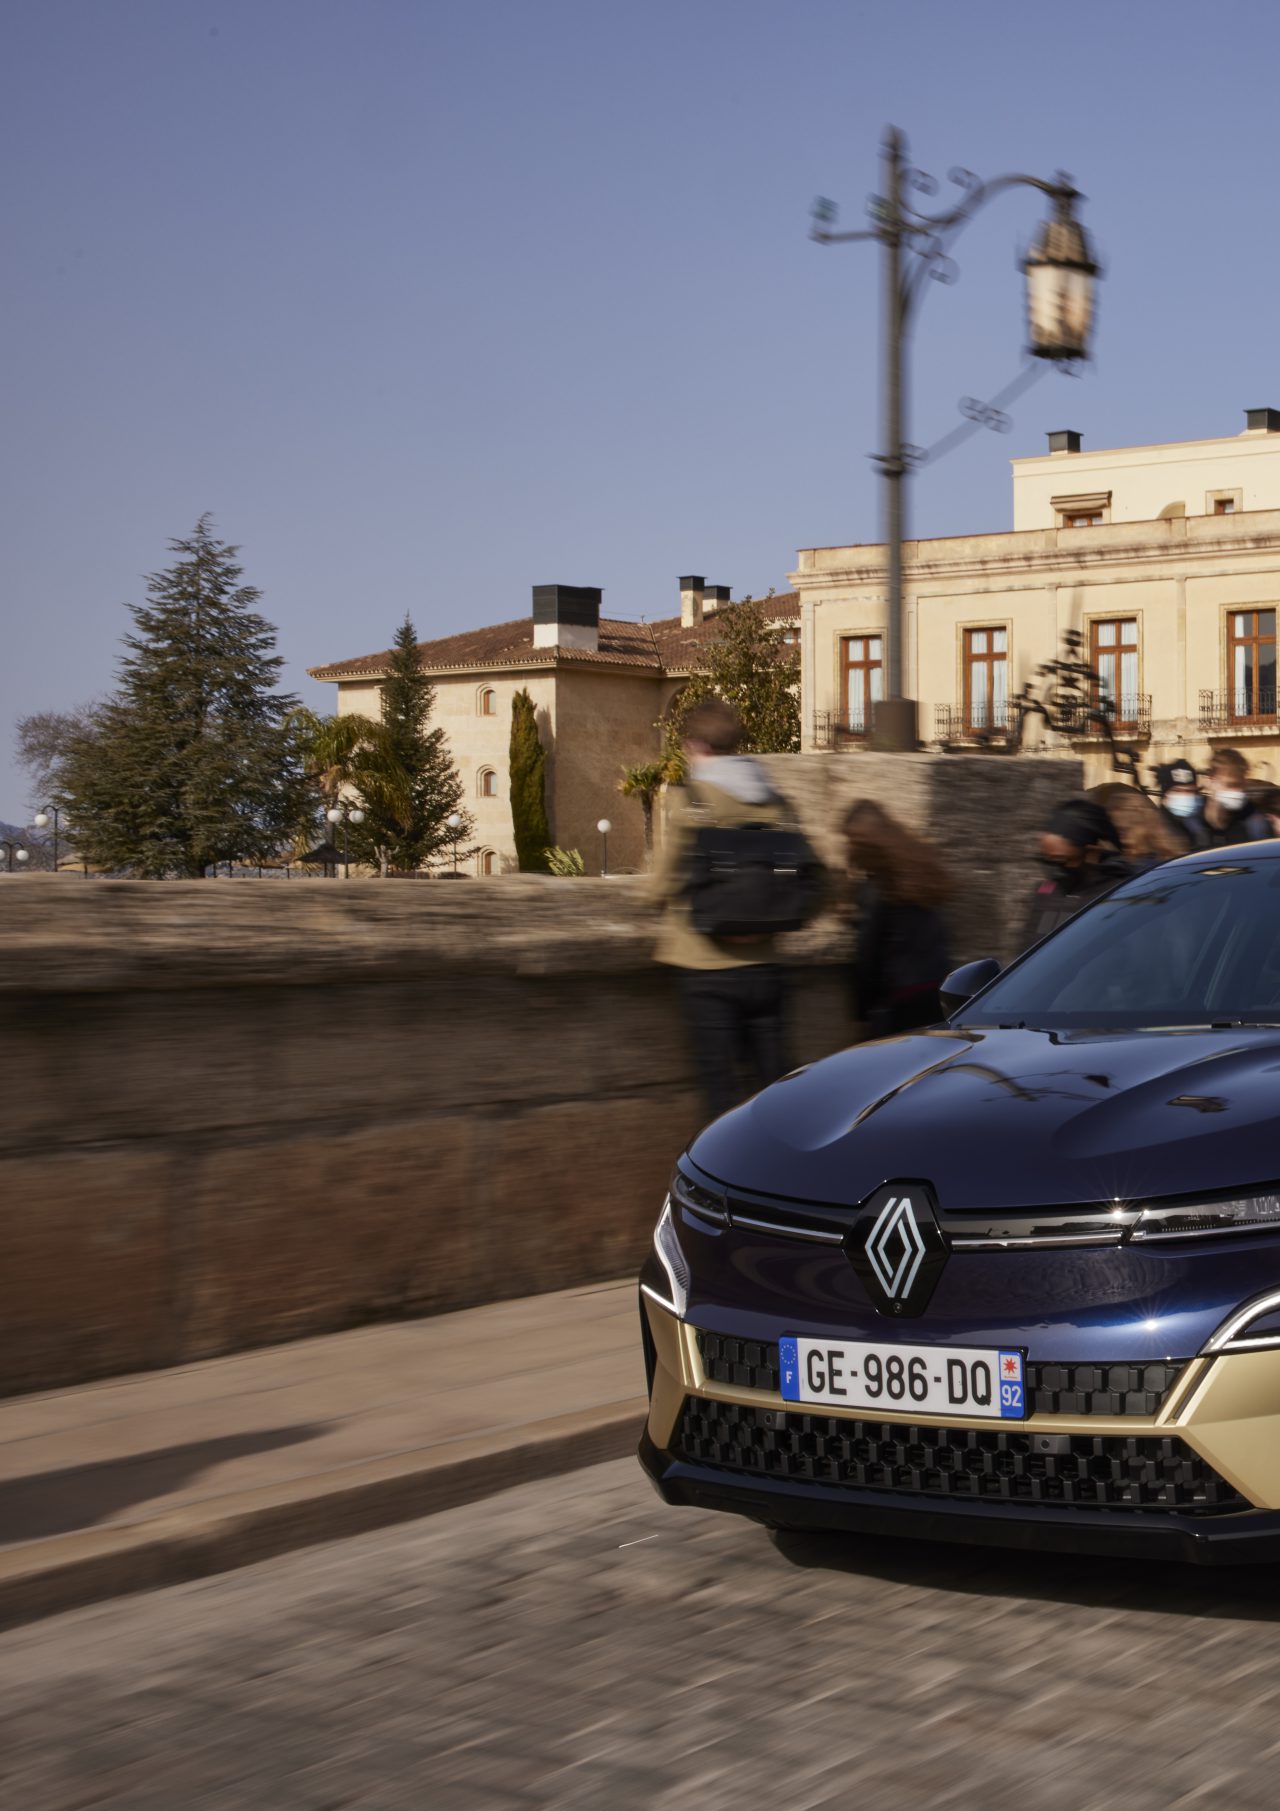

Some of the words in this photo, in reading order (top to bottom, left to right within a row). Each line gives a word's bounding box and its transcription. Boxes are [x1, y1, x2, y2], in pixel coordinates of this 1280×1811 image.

[786, 1371, 793, 1384] F
[807, 1349, 992, 1406] GE-986-DQ
[1001, 1384, 1022, 1407] 92
